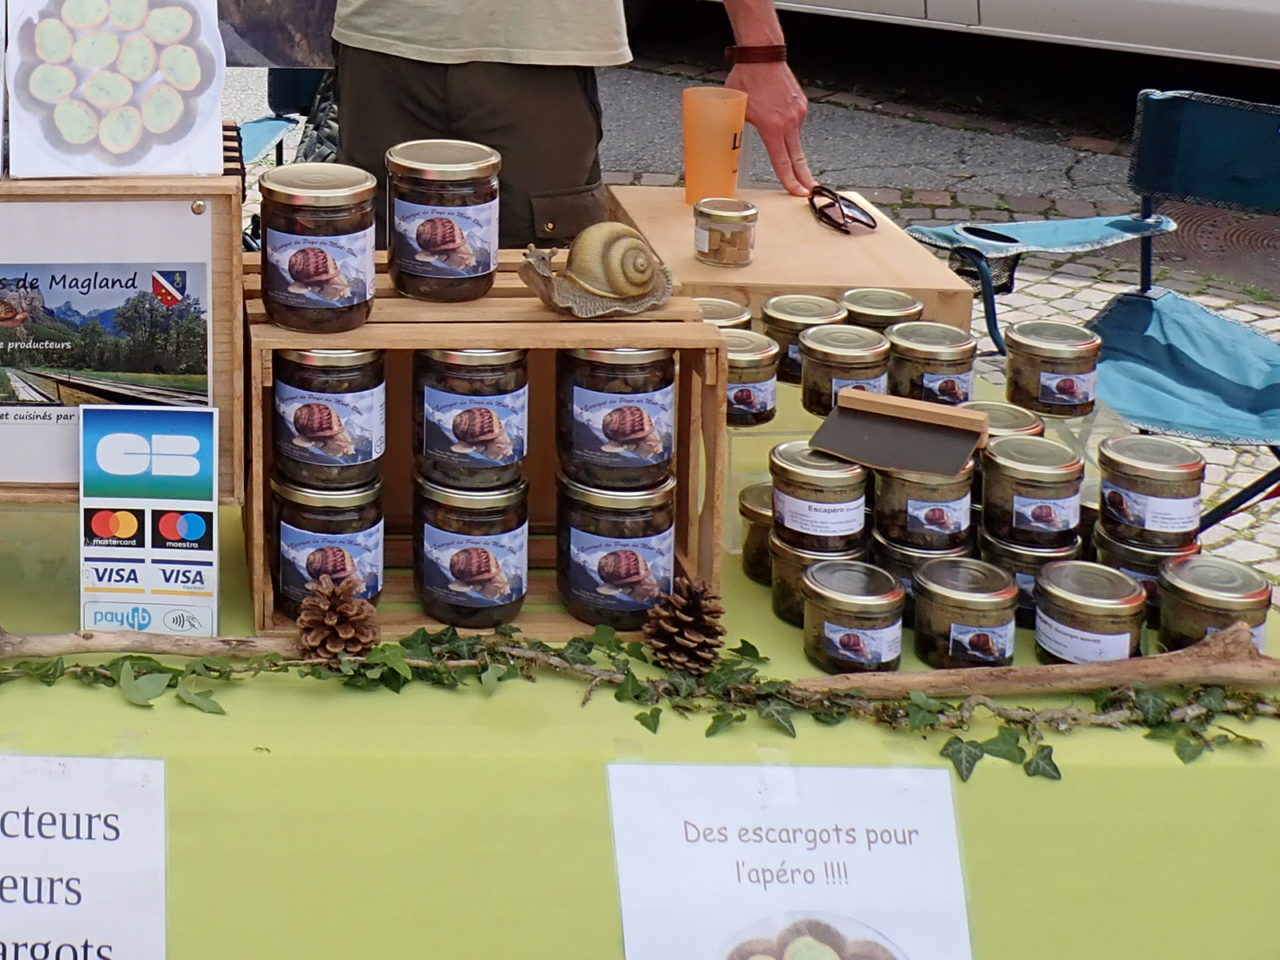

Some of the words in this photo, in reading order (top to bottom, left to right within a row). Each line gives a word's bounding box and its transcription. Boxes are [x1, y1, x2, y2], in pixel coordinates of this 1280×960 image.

[16, 272, 40, 291] de
[49, 272, 138, 296] Magland
[7, 339, 72, 352] producteurs
[0, 412, 10, 420] et
[13, 411, 52, 421] cuisinés
[56, 413, 75, 423] par
[96, 432, 200, 476] CB
[92, 538, 136, 546] mastercard
[166, 541, 199, 549] maestro
[91, 567, 139, 583] VISA
[158, 568, 205, 585] VISA
[683, 820, 728, 844] Des
[737, 824, 857, 851] escargots
[865, 826, 919, 851] pour
[735, 860, 816, 891] l'apéro
